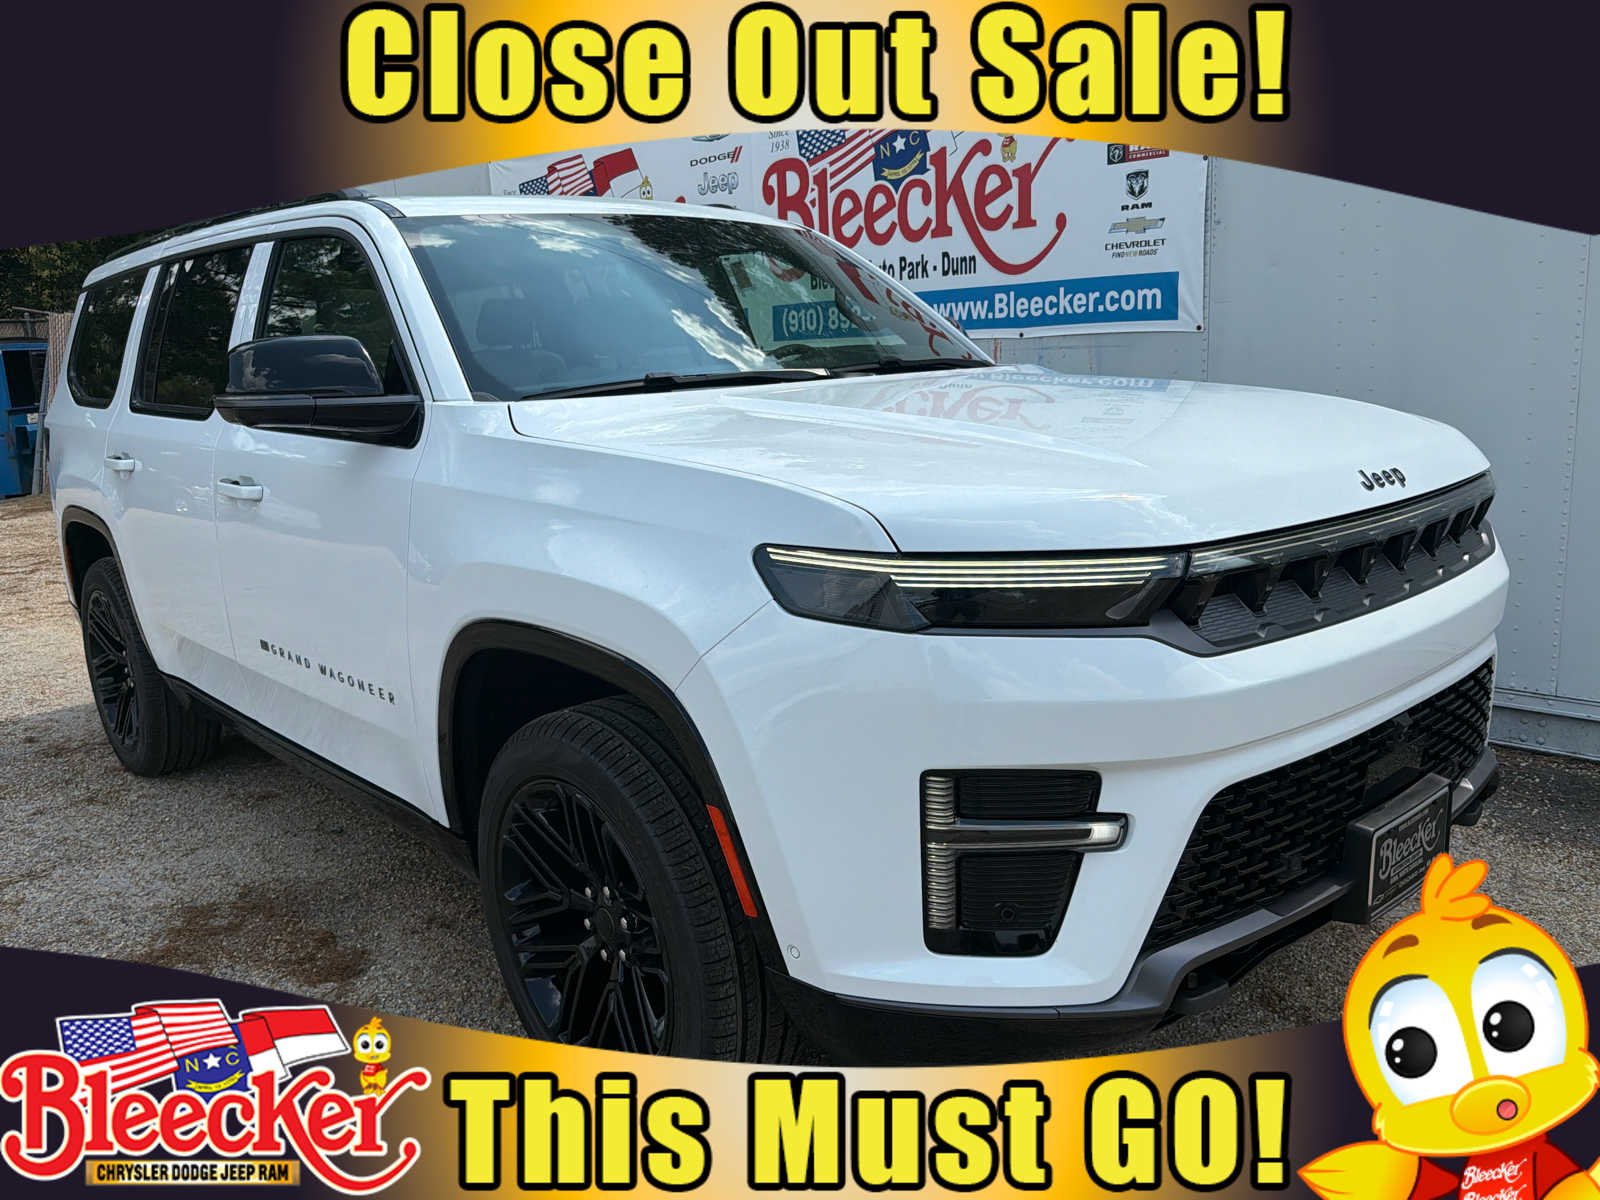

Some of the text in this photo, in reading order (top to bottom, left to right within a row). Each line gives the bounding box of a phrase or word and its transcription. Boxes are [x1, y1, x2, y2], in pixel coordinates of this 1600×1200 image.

[771, 139, 791, 152] 1938
[690, 151, 736, 167] DODGE
[698, 172, 739, 195] Jeep
[763, 137, 1075, 275] Bleecker
[1121, 202, 1152, 211] RAM
[1105, 239, 1166, 251] CHEVROLET
[899, 254, 929, 280] Park
[941, 251, 977, 276] Dunn
[933, 287, 1162, 321] www.Bleecker.com
[782, 305, 824, 336] (910)
[1358, 467, 1406, 491] Jeep
[270, 644, 396, 705] GRAND WAGONEER
[1379, 808, 1444, 879] Bleecker
